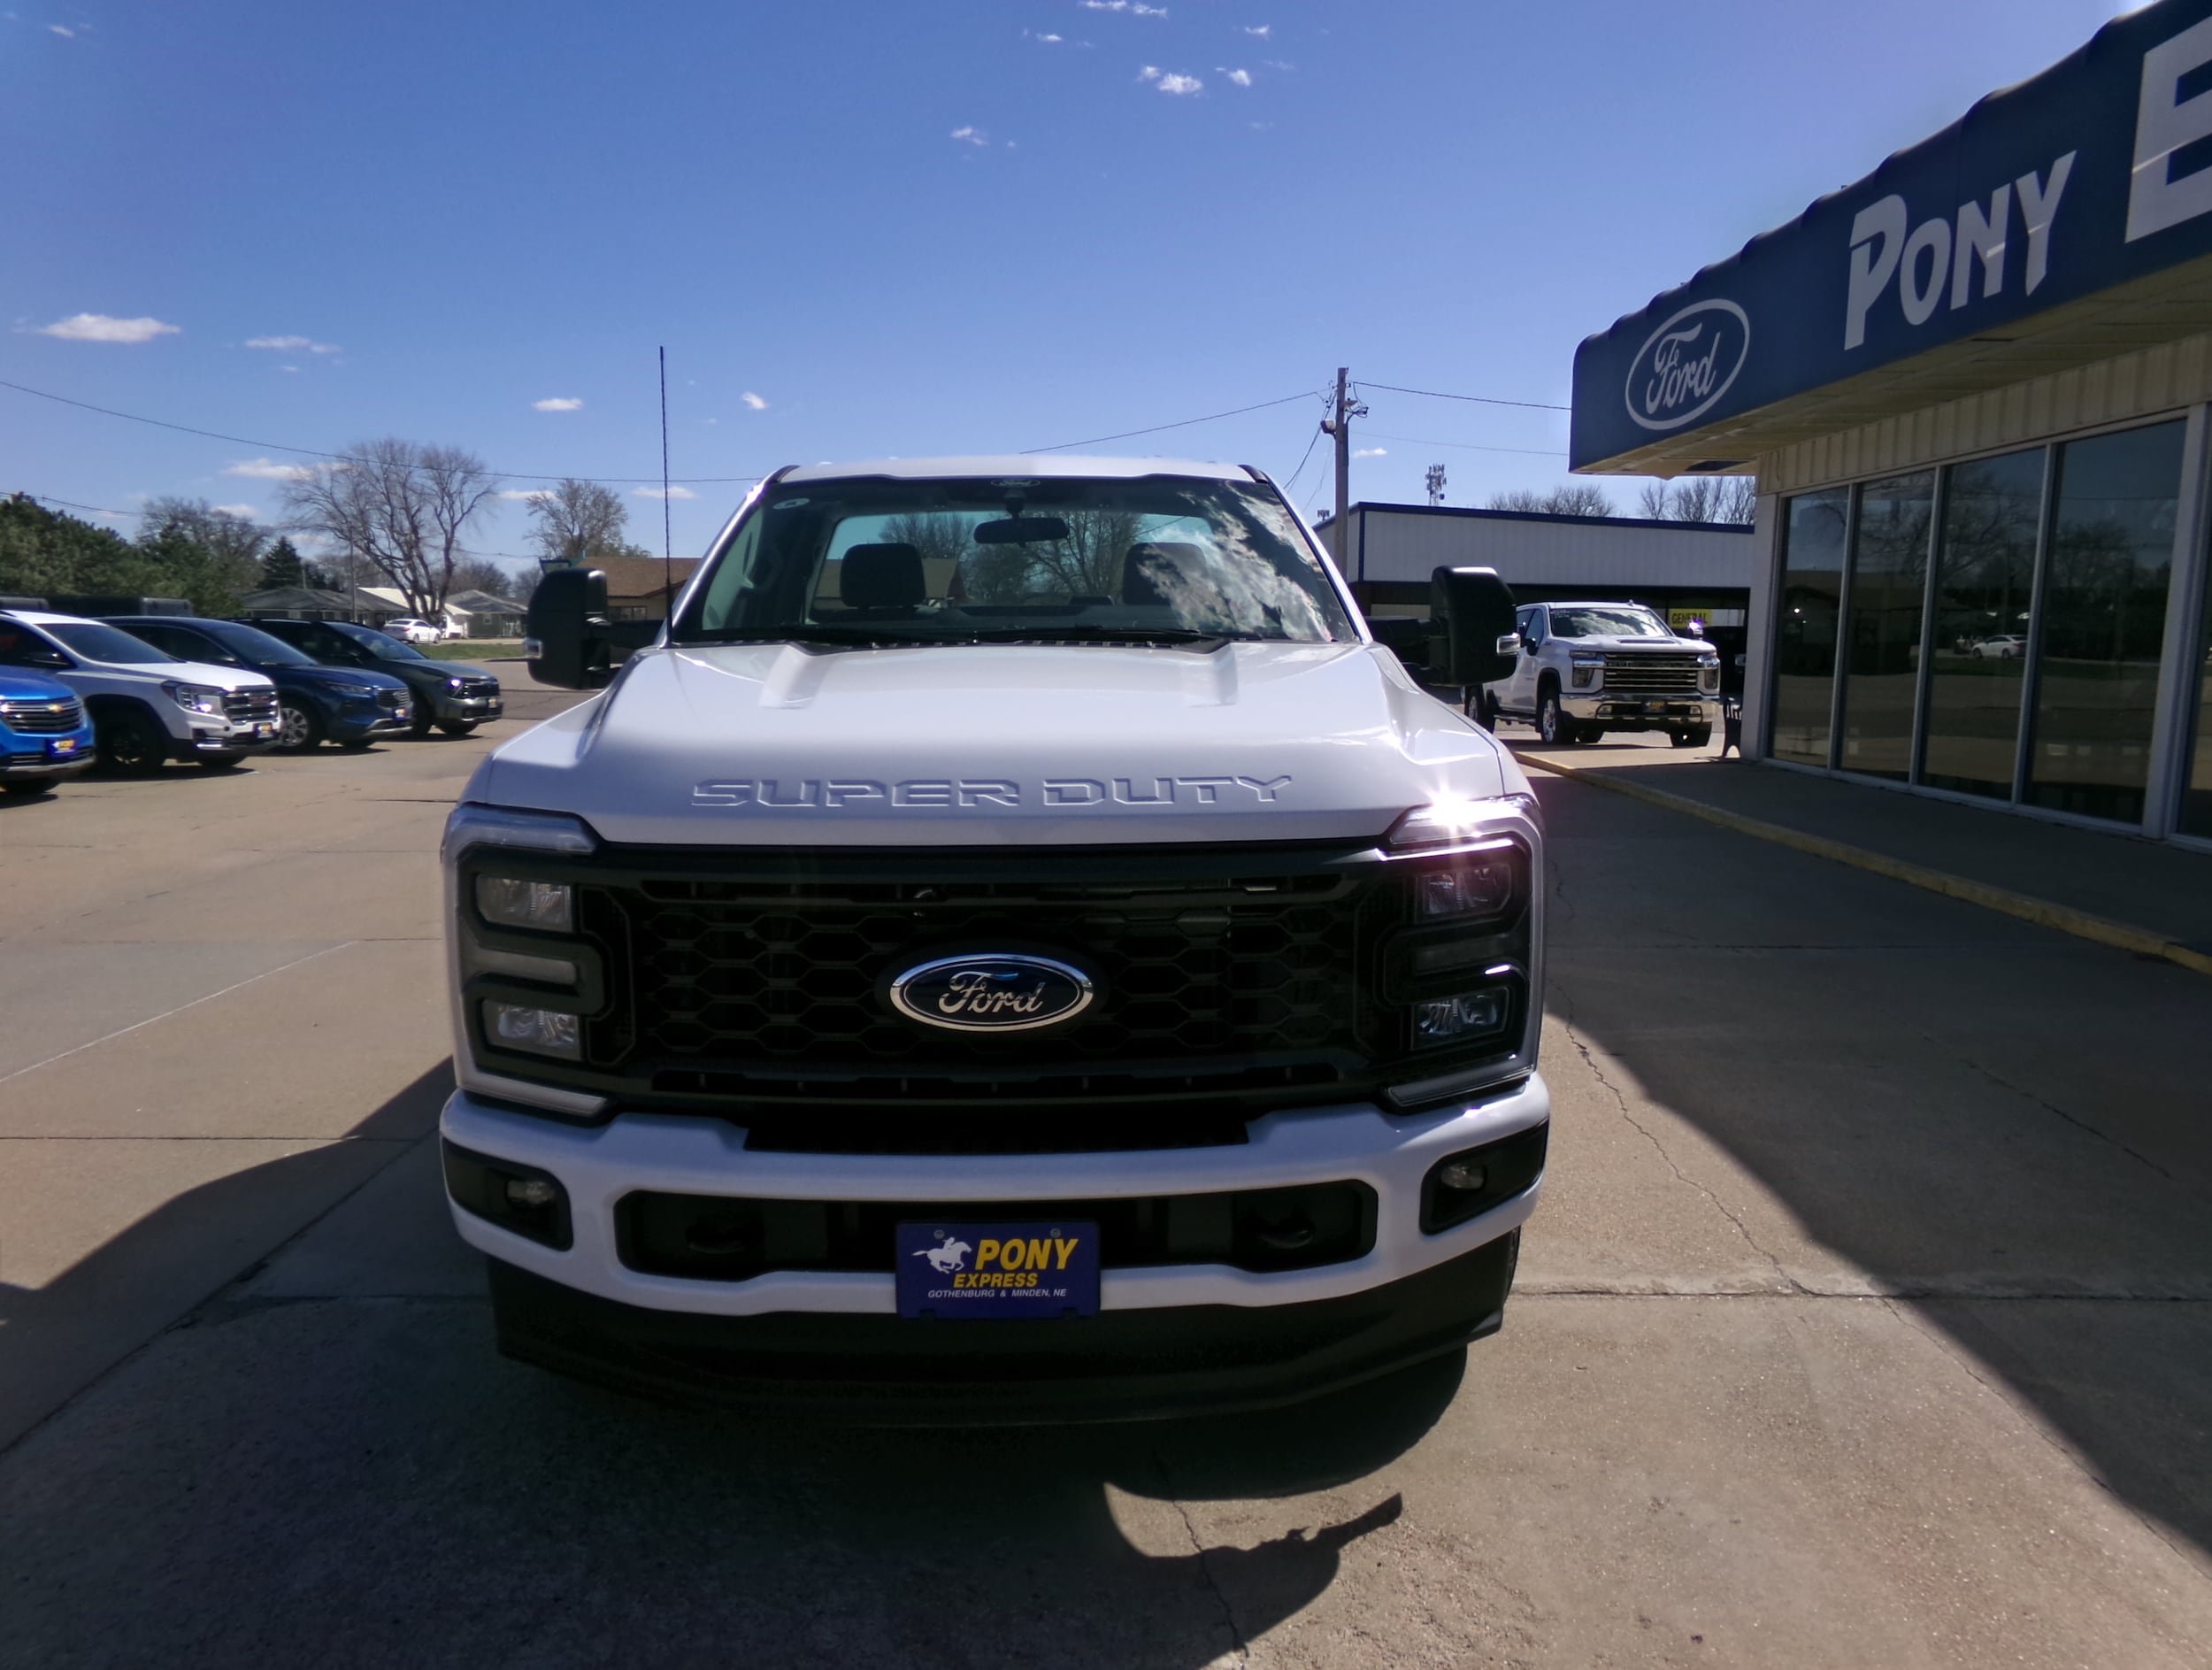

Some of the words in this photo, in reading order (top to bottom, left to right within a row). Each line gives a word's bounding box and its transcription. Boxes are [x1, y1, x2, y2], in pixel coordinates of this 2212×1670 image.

[1844, 150, 2077, 351] PONY
[1647, 322, 1721, 414] Ford
[692, 779, 1020, 807] SUPER
[1042, 774, 1293, 806] DUTY
[939, 971, 1045, 1013] Ford
[975, 1239, 1078, 1271] PONY
[928, 1289, 995, 1298] GOTHENBURG
[1011, 1289, 1050, 1297] MINDEN,
[953, 1273, 1038, 1288] EXPRESS
